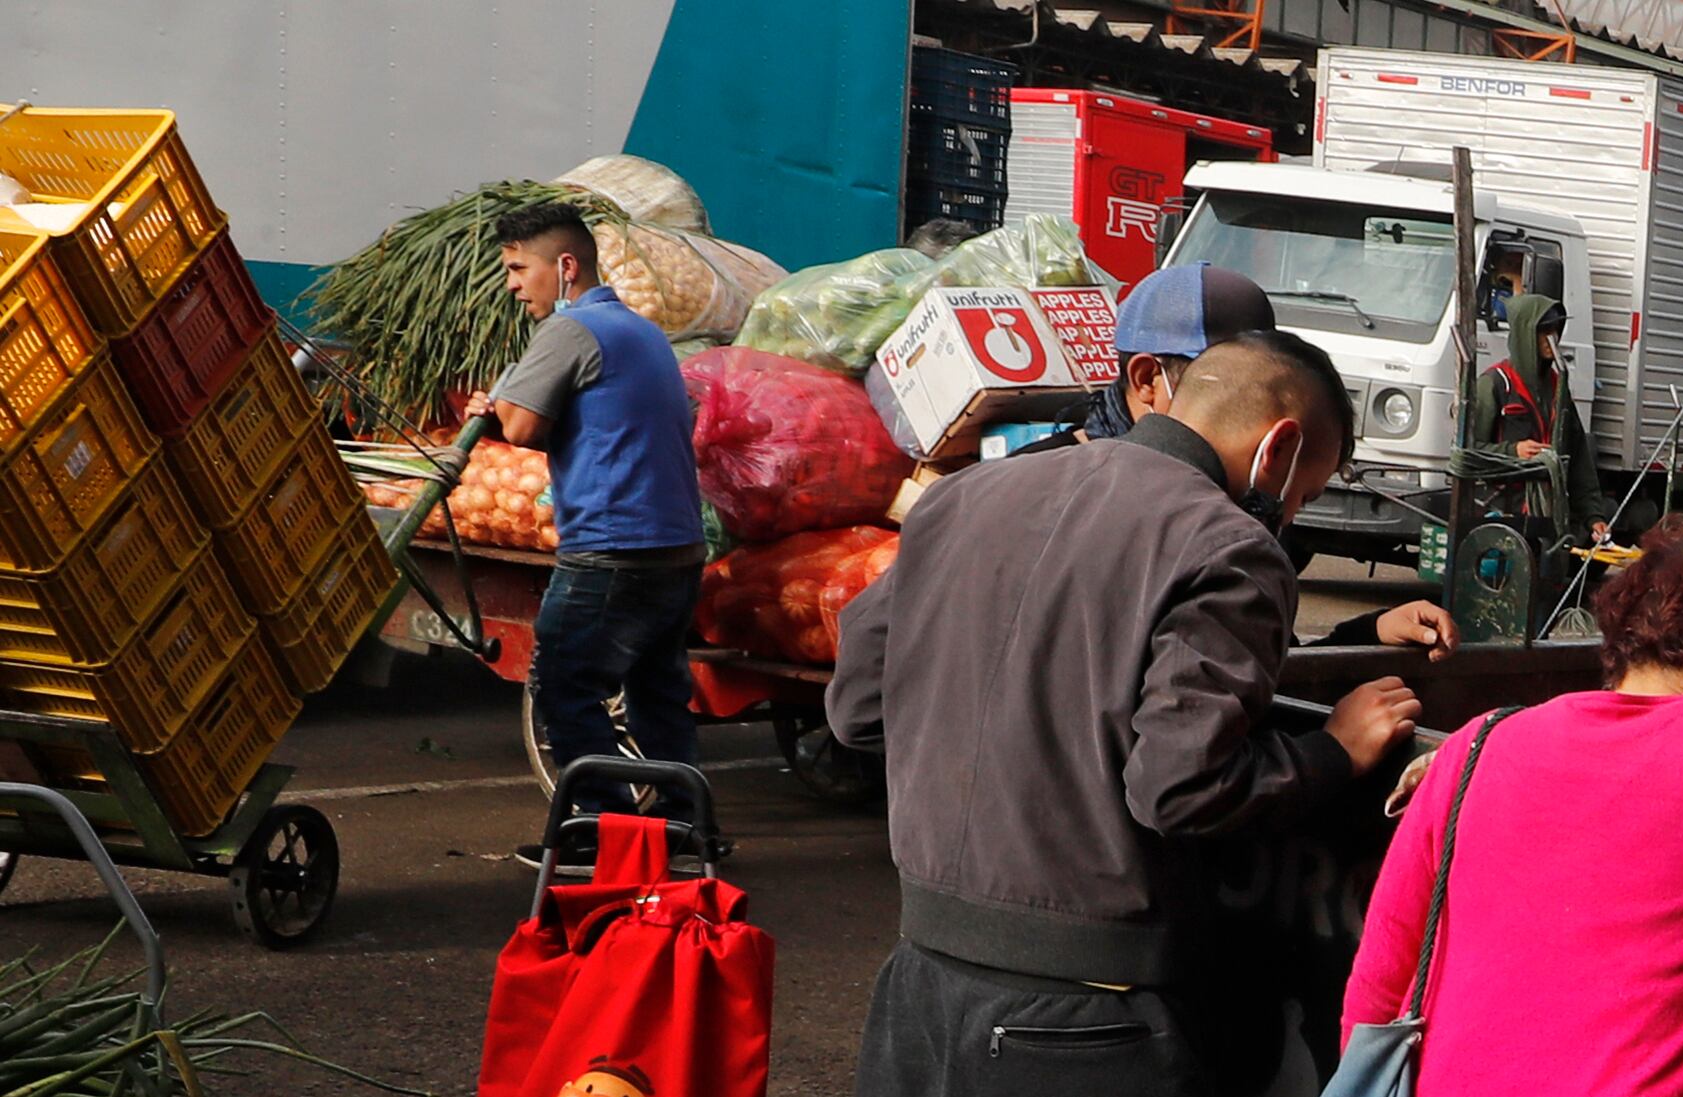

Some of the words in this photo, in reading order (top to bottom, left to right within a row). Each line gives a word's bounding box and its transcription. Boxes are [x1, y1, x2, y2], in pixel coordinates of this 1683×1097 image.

[1440, 75, 1526, 97] BENFOR
[1109, 165, 1165, 201] GT
[947, 290, 1022, 307] unifrutti
[1037, 293, 1105, 309] APPLES
[1047, 309, 1114, 325] APPLES
[896, 304, 939, 359] unifrutti
